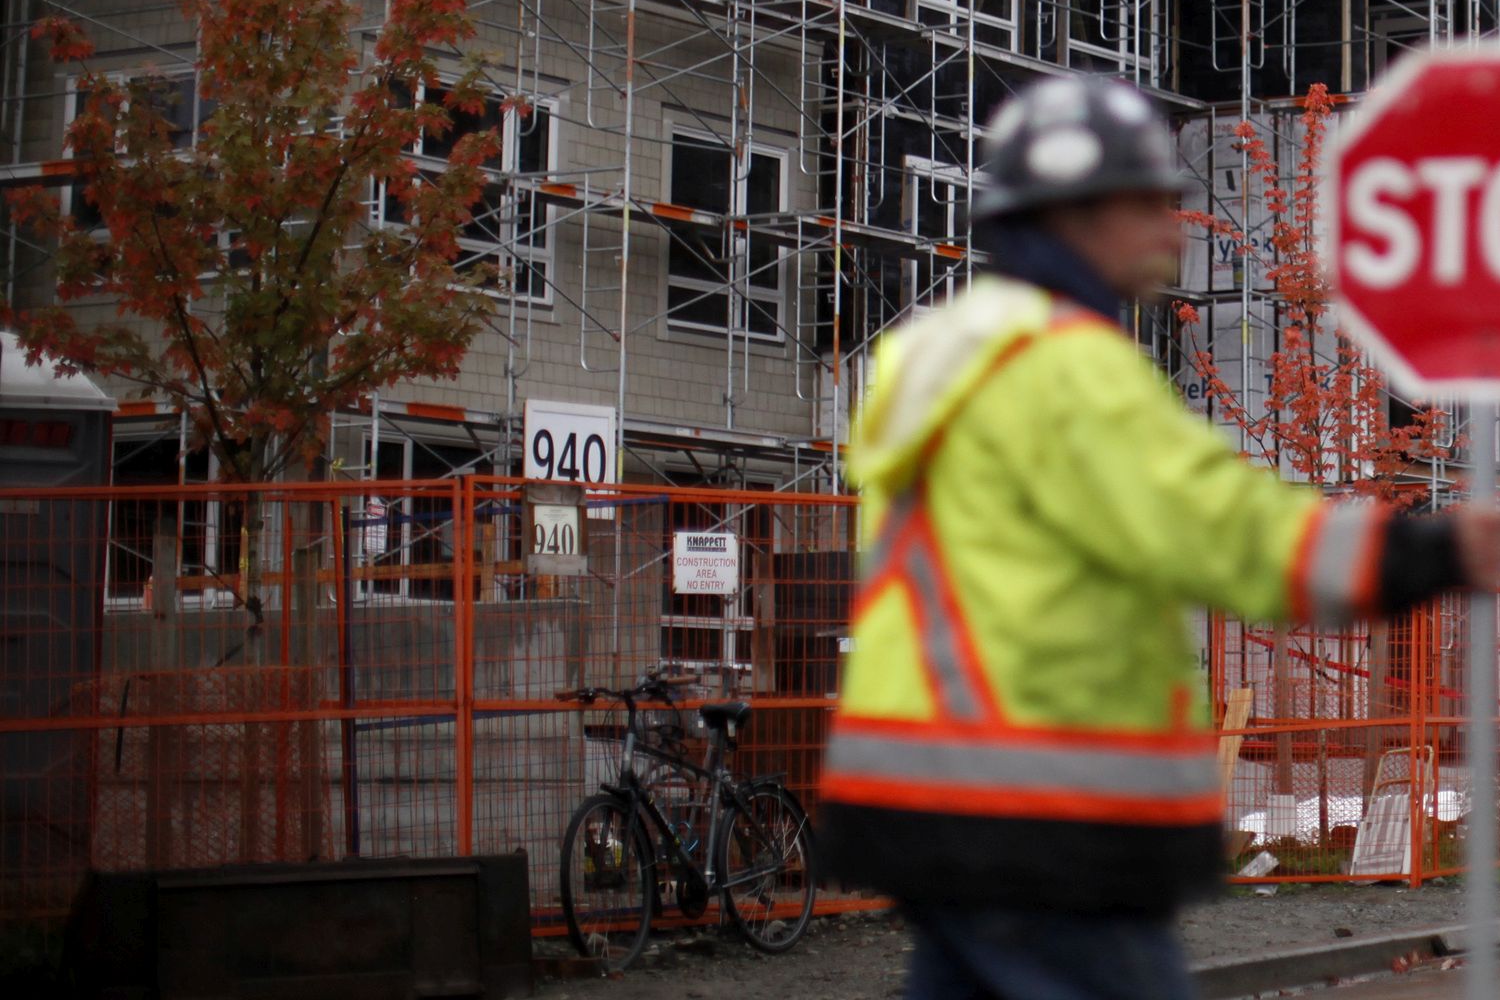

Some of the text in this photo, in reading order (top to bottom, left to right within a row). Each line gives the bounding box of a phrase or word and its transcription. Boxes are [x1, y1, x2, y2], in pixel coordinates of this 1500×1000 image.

[533, 429, 607, 484] 940
[534, 523, 574, 555] 940
[687, 536, 727, 547] KNAPPETT
[677, 556, 737, 568] CONSTRUCTION
[696, 569, 717, 579] AREA
[687, 580, 726, 590] NO ENTRY
